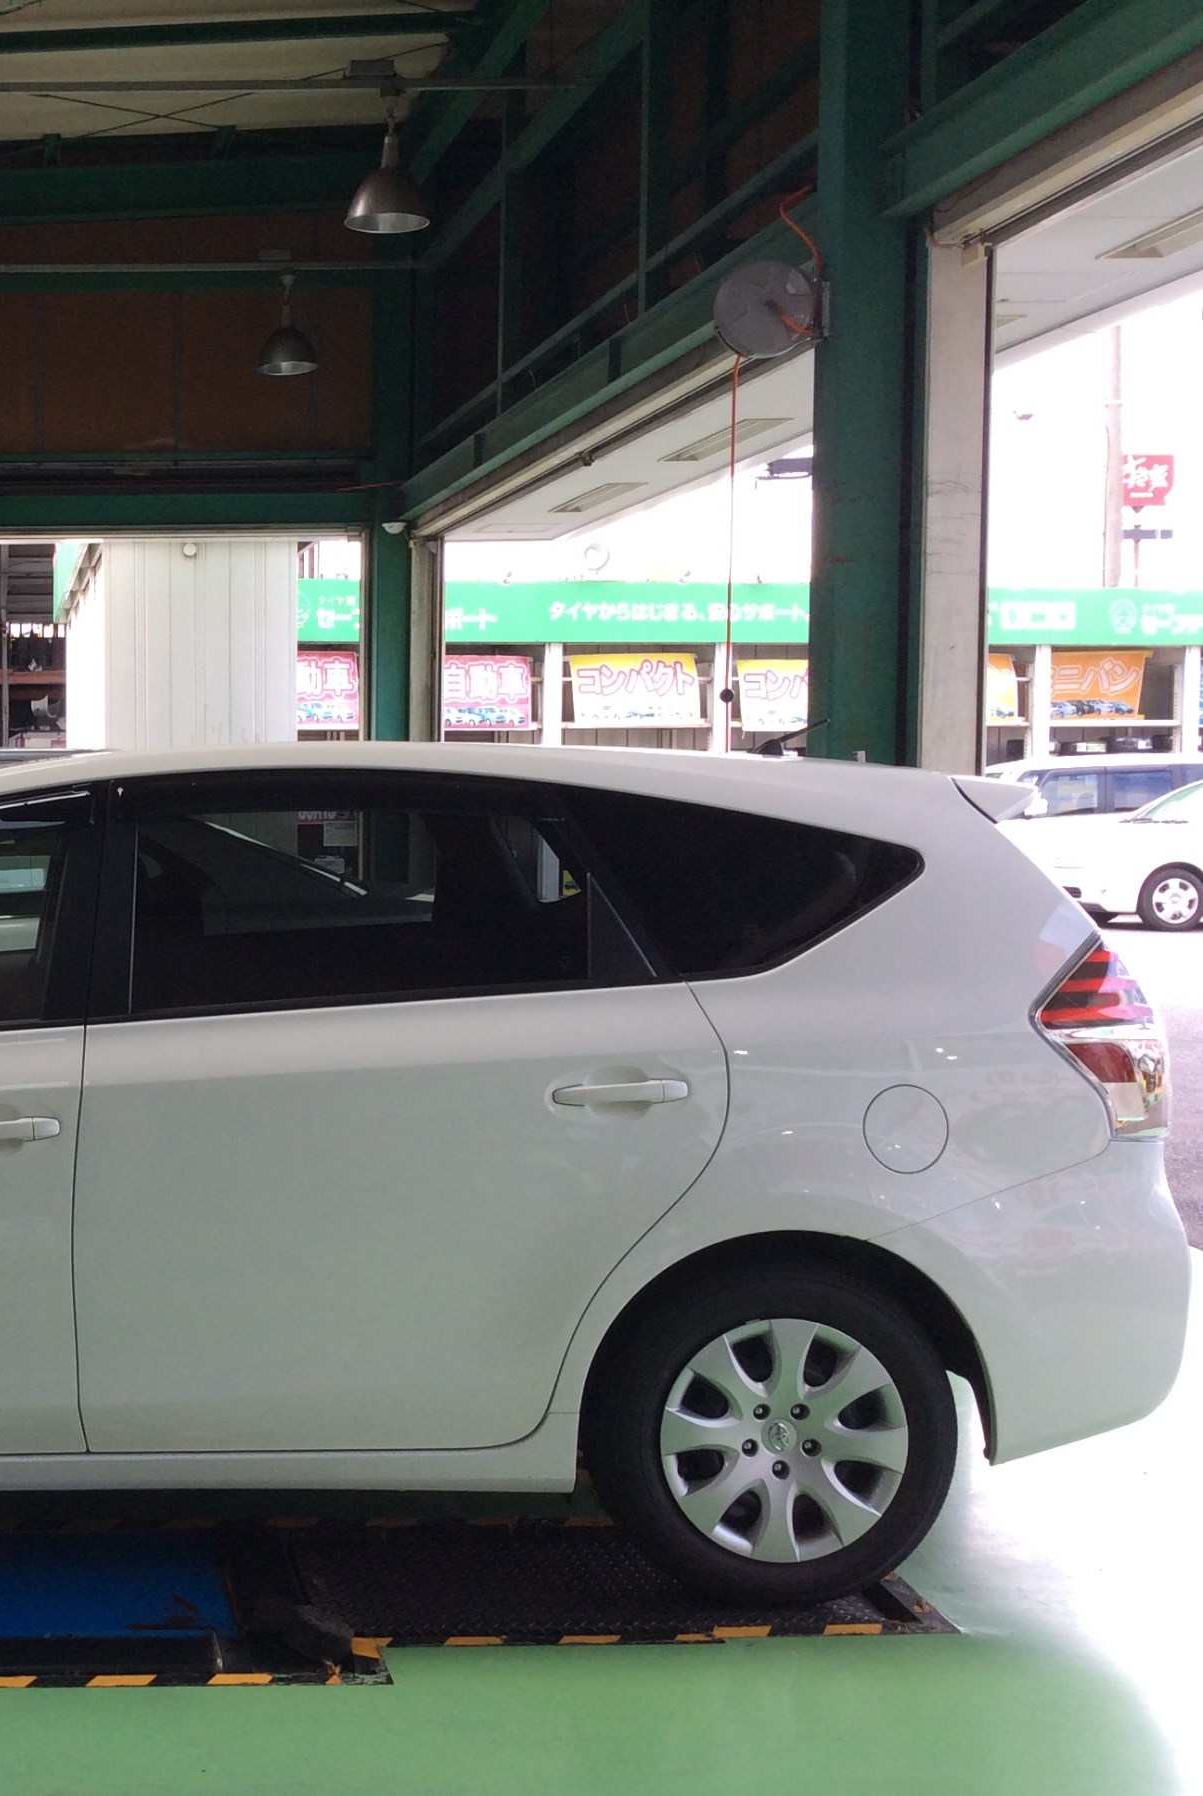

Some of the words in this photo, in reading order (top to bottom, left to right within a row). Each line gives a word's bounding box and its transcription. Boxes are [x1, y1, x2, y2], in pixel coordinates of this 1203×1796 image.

[576, 659, 698, 697] コンパクト
